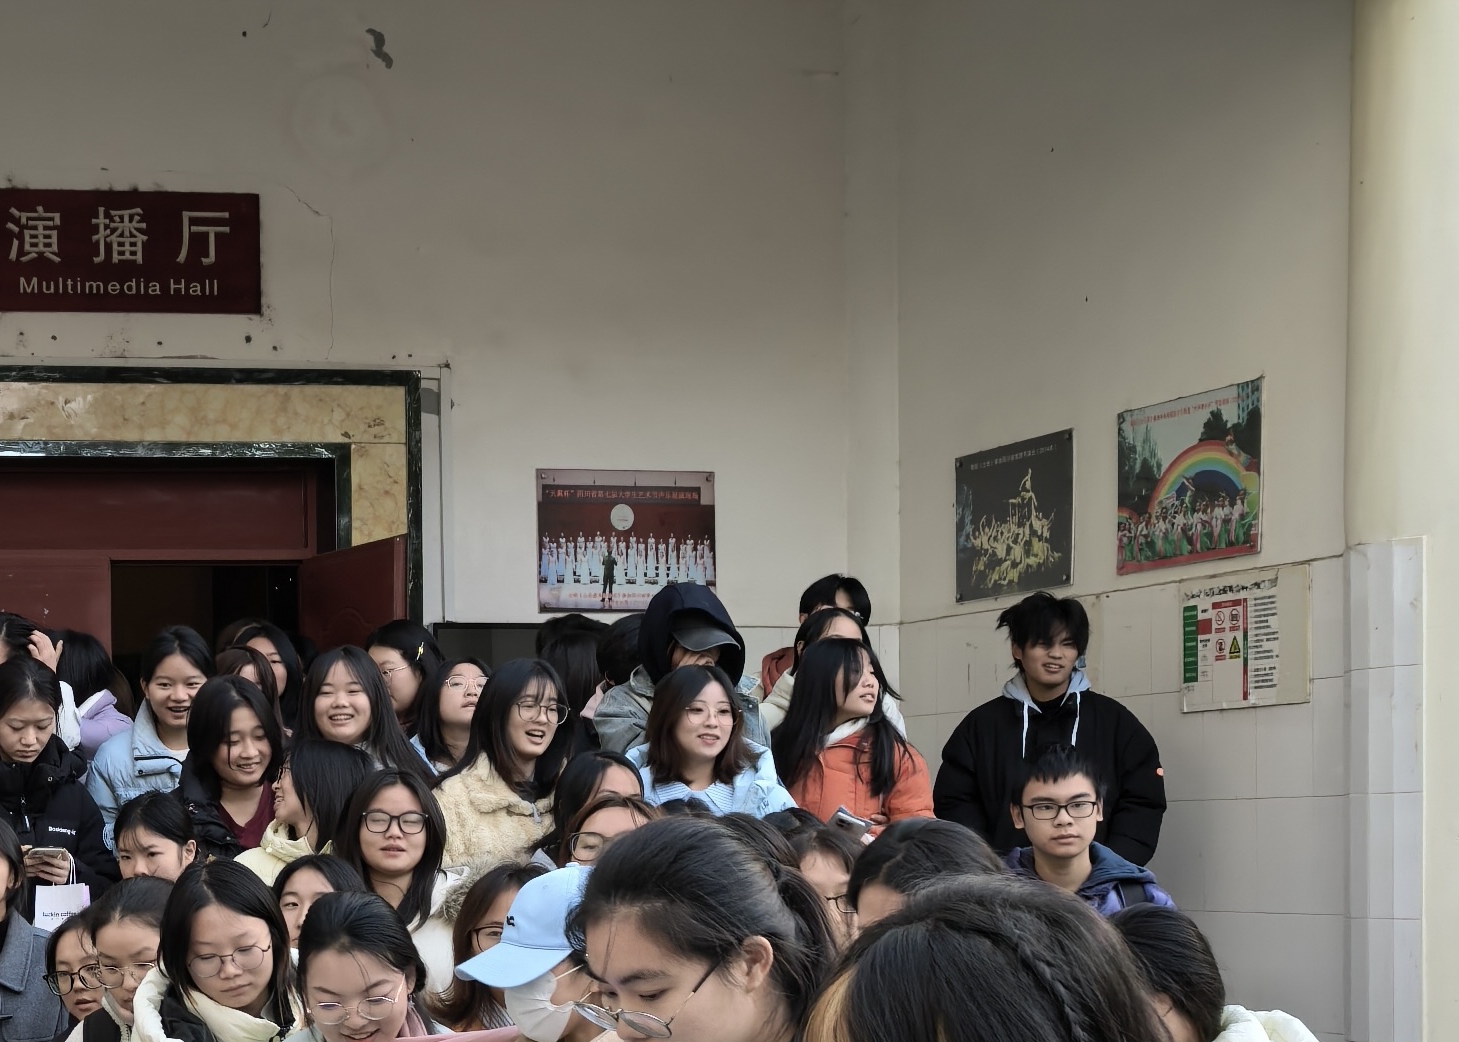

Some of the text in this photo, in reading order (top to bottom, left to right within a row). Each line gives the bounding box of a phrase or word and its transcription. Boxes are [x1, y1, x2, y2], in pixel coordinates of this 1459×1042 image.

[6, 206, 230, 265] 演播厅
[19, 277, 219, 296] Multimedia Hall
